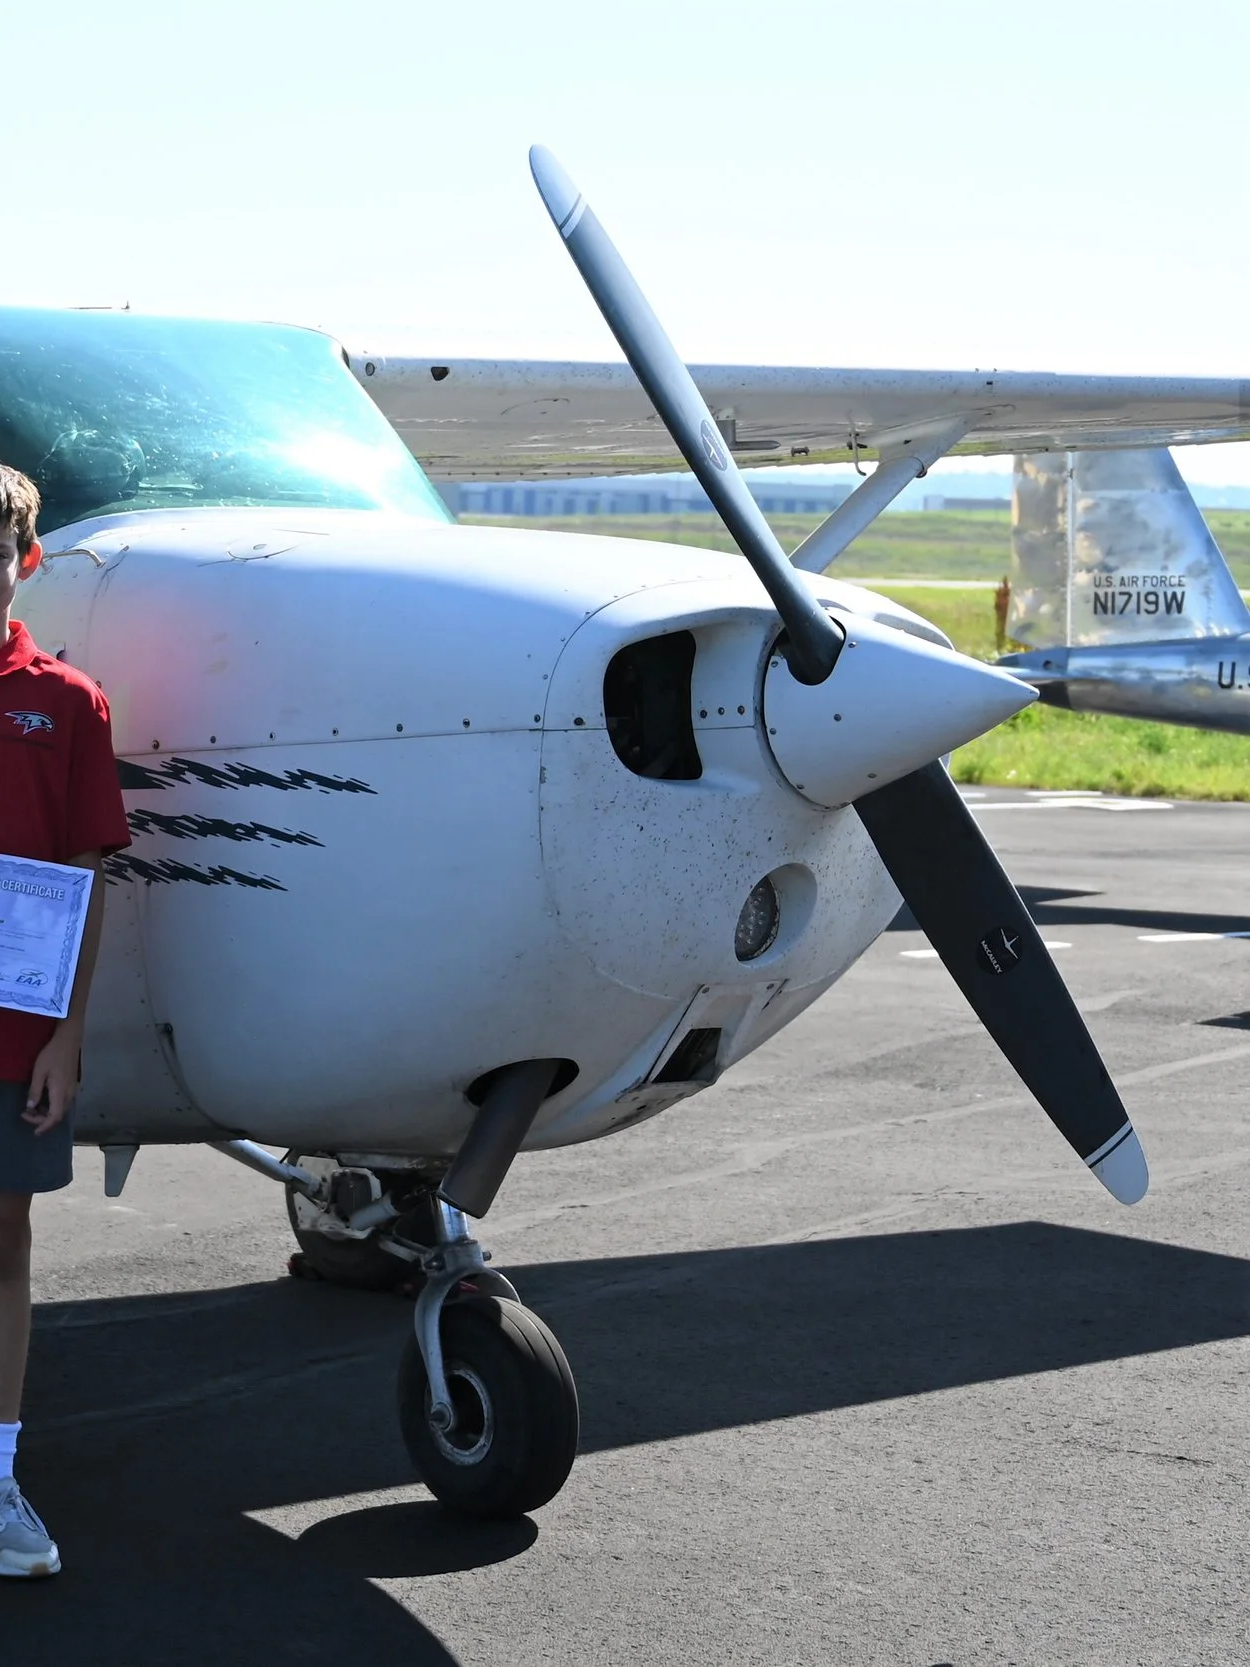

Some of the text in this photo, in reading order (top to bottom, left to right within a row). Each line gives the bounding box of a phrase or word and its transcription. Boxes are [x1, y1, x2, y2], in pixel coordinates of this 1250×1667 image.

[1093, 575, 1186, 588] U.S. AIR FORCE
[1093, 590, 1186, 615] N1719W
[1218, 661, 1250, 689] U.
[1, 879, 66, 900] CERTIFICATE
[15, 975, 42, 986] EAA
